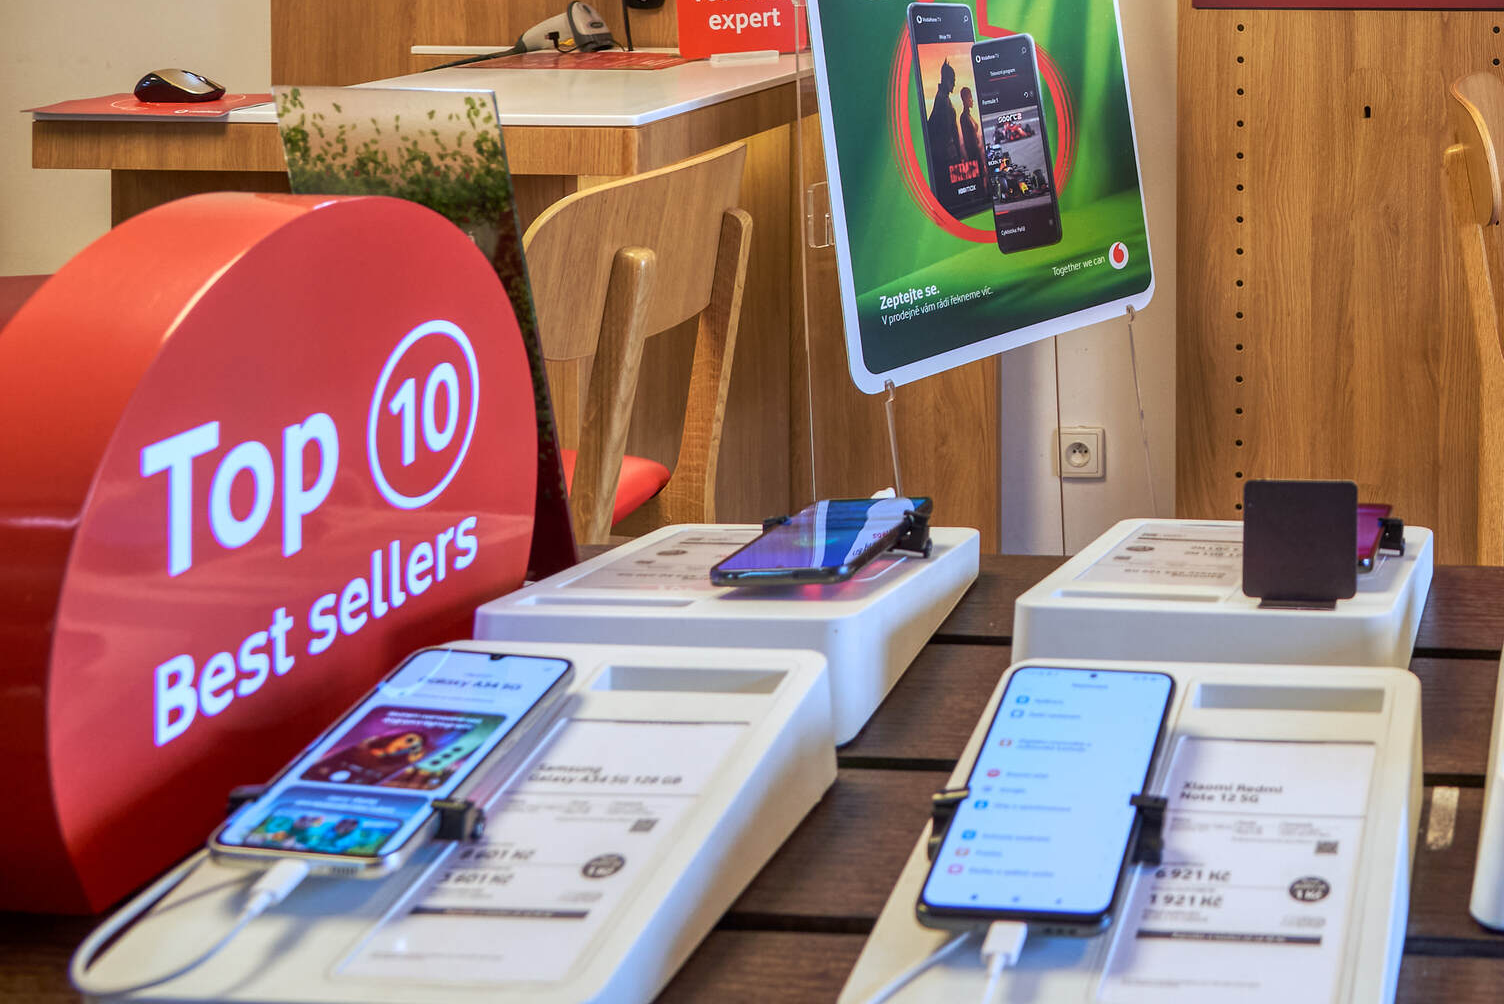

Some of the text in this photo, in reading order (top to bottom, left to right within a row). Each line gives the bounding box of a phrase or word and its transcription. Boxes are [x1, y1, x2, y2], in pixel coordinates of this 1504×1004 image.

[708, 8, 781, 34] expert
[1052, 256, 1106, 276] Together we can
[879, 284, 940, 310] Zeptejte se.
[881, 315, 888, 325] V
[888, 308, 920, 326] prodejně
[920, 302, 936, 314] vám
[936, 299, 950, 310] rádi
[950, 290, 981, 305] řekneme
[140, 362, 460, 577] Top 10
[154, 516, 479, 748] Best sellers
[528, 775, 576, 785] Galaxy
[1183, 781, 1283, 794] Xiaomi Redmi
[1180, 792, 1259, 804] Note 12 5G
[1171, 867, 1203, 880] 921
[1163, 893, 1196, 907] 921
